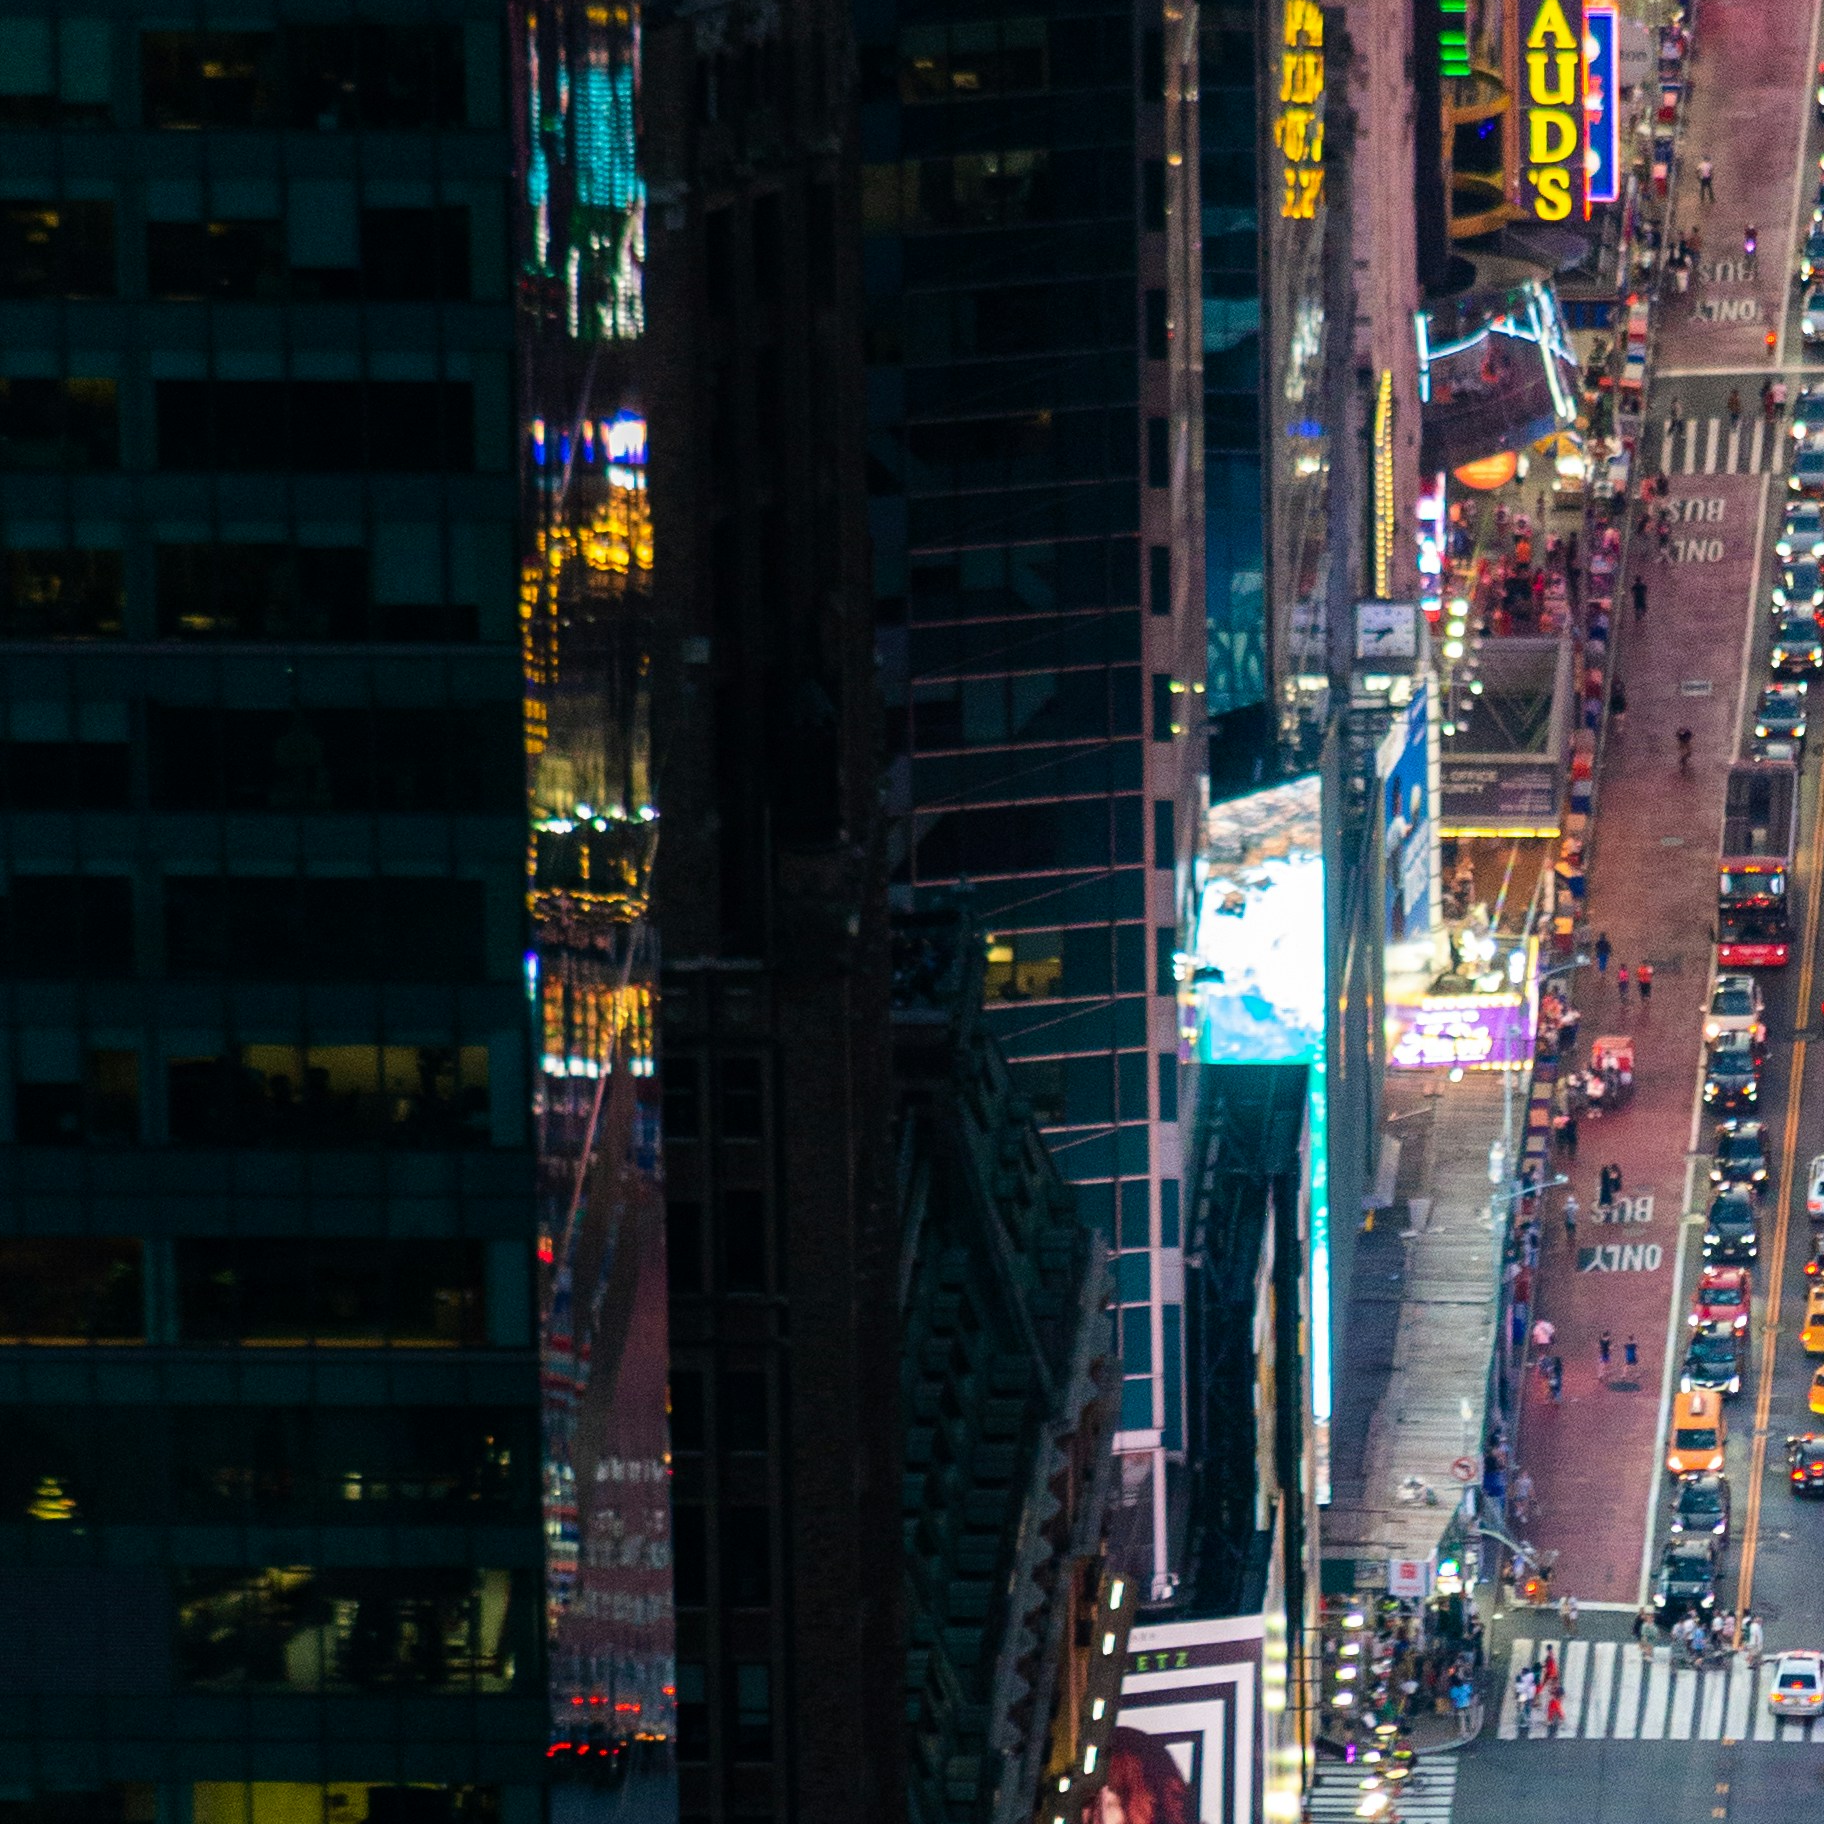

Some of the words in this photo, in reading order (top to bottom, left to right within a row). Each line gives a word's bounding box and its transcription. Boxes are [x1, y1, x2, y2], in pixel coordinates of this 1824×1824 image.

[1697, 260, 1754, 283] BUS
[1690, 298, 1756, 322] ONLY
[1665, 497, 1726, 523] BUS
[1655, 539, 1724, 564] ONLY
[1590, 1196, 1655, 1224] BUS
[1583, 1243, 1663, 1273] ONLY
